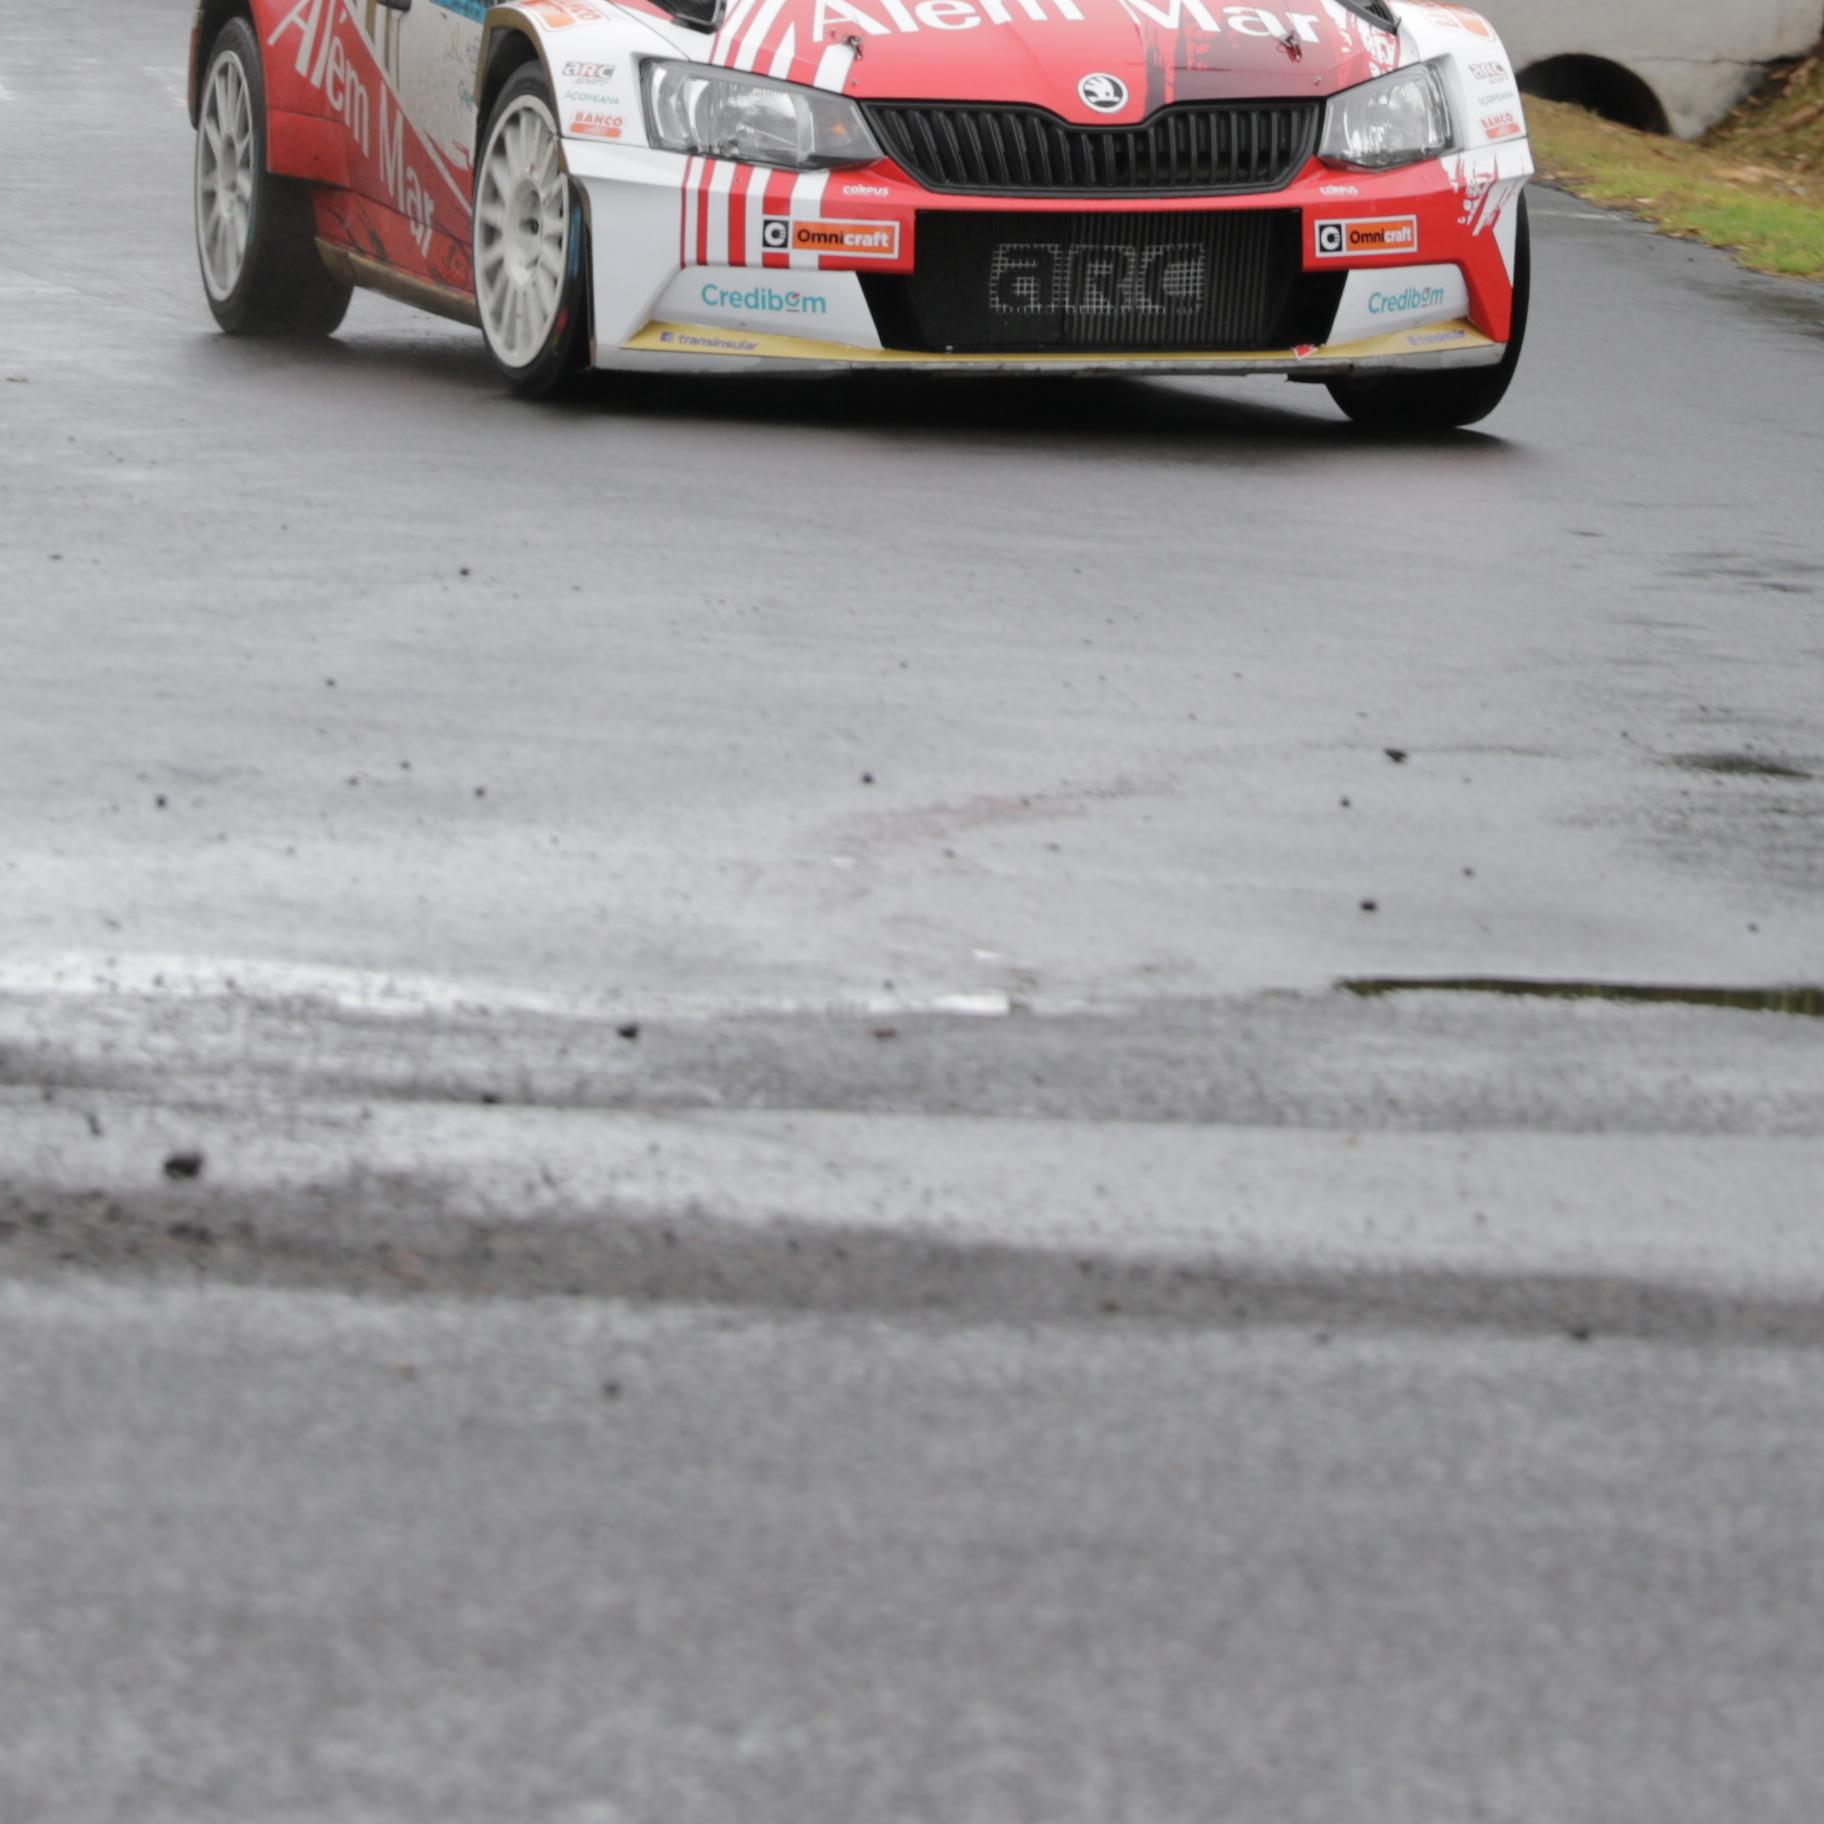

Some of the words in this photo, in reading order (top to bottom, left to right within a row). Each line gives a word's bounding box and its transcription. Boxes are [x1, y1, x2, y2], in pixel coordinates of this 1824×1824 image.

[379, 79, 435, 258] Mar
[796, 228, 890, 248] Omnicraft
[1349, 227, 1412, 245] Omnicraft
[701, 283, 827, 314] Credibom
[1367, 286, 1445, 314] Credibom
